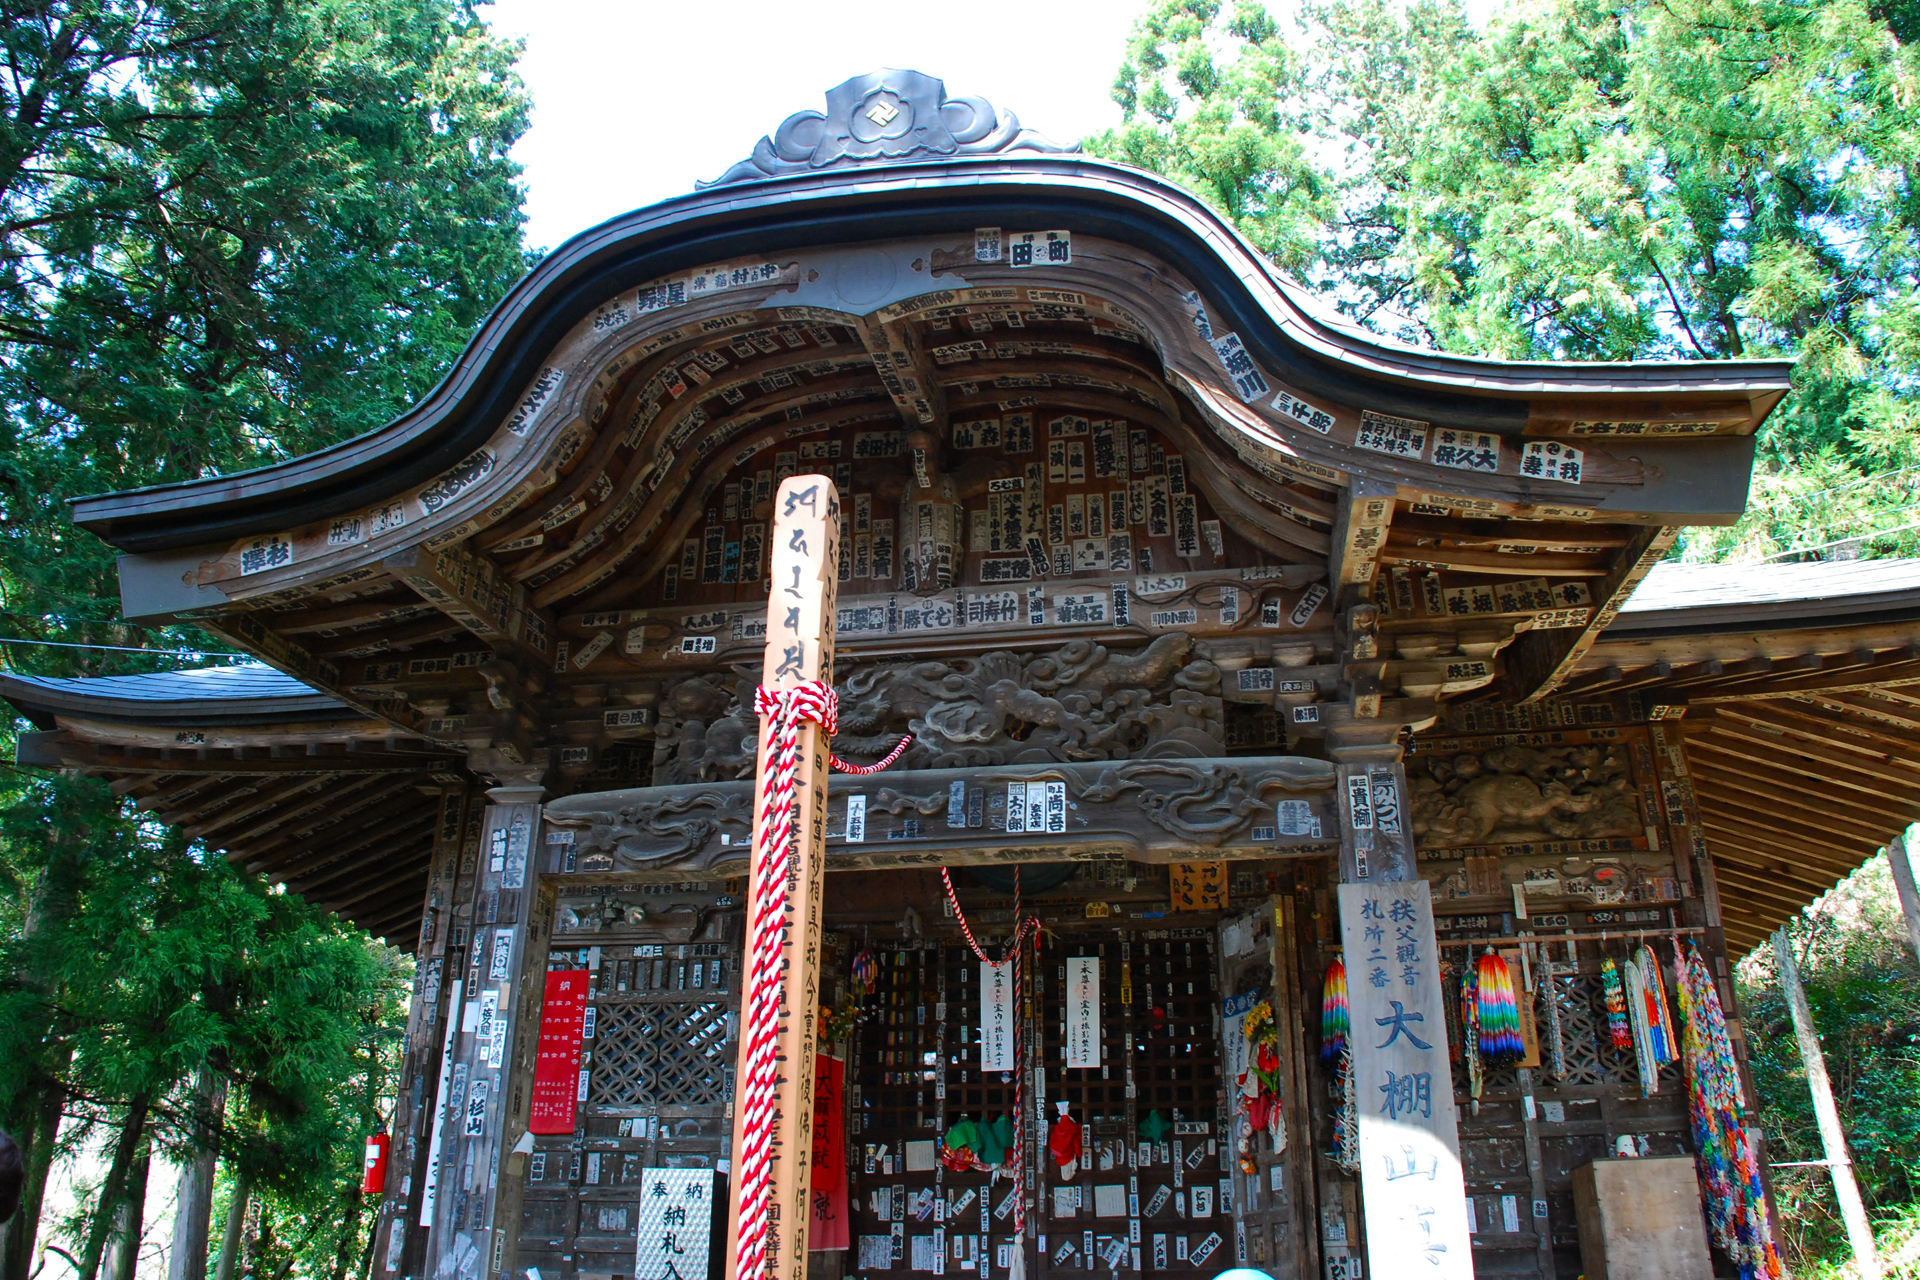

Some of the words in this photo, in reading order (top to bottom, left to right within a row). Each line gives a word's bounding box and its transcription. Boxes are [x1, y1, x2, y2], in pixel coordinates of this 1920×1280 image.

[1360, 898, 1385, 988] 札所二番
[652, 1180, 669, 1199] 奉
[686, 1182, 703, 1200] 納
